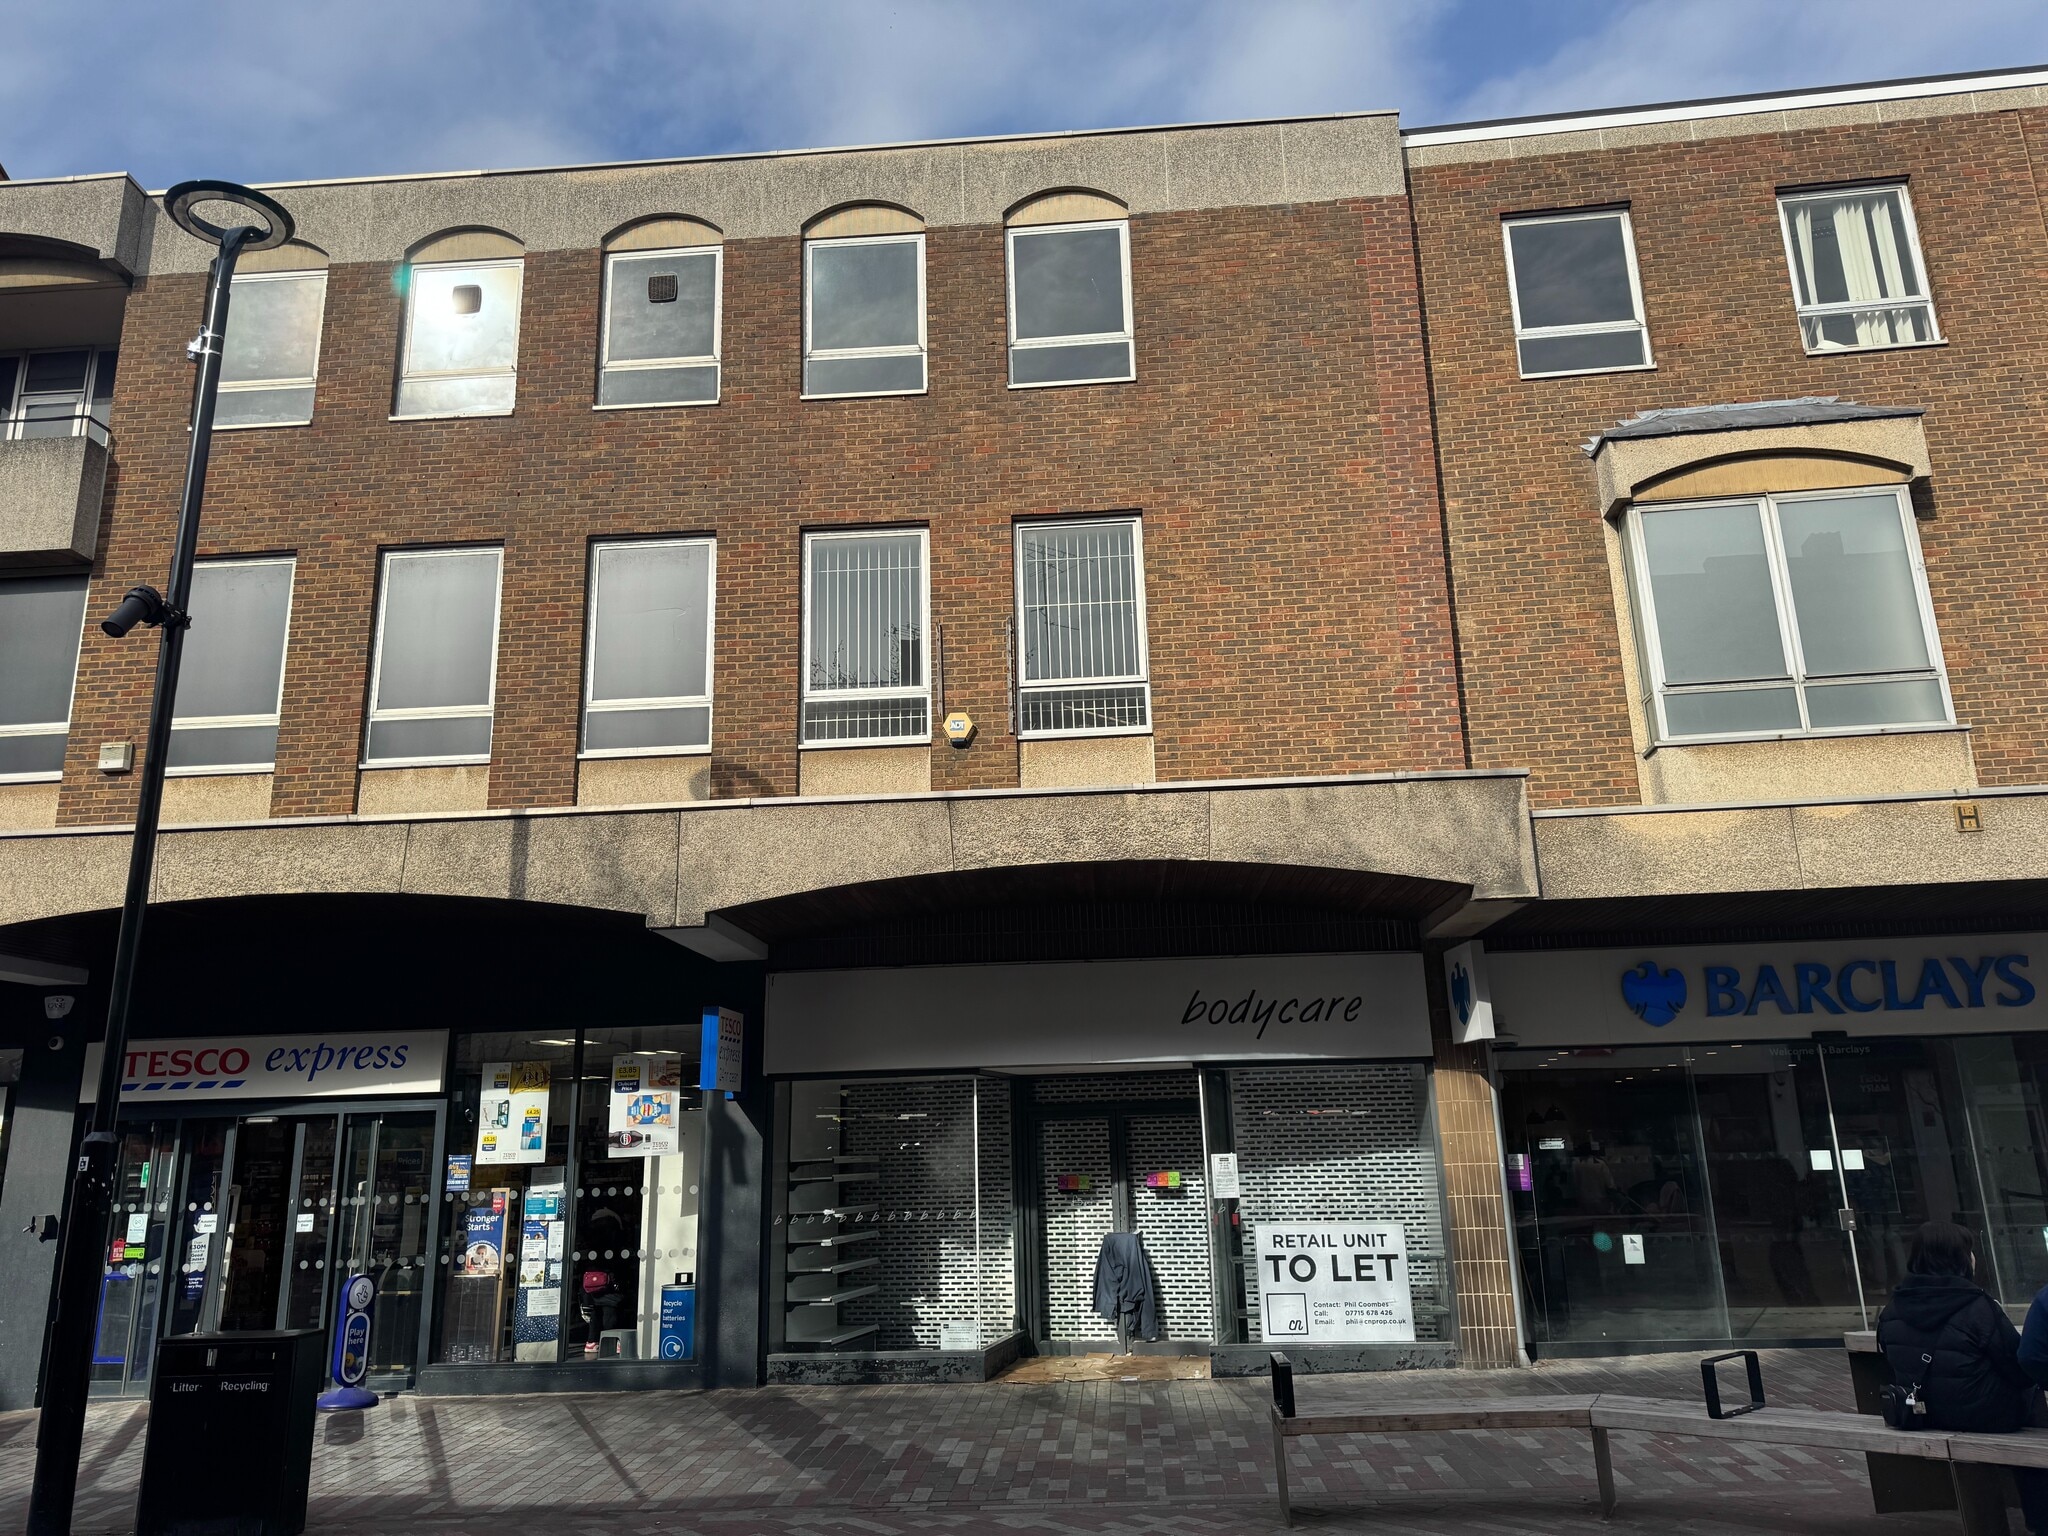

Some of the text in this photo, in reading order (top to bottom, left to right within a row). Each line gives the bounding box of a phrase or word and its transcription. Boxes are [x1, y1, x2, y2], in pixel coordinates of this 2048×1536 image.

[950, 721, 964, 730] ADT
[1704, 954, 2036, 1017] BARCLAYS
[1181, 989, 1362, 1040] bodycare
[720, 1016, 741, 1036] TESCO
[1769, 1048, 1815, 1056] Welcome
[1829, 1044, 1871, 1056] Barclays
[126, 1042, 409, 1082] TESCO express
[618, 1066, 637, 1074] £3.85
[465, 1214, 500, 1224] Stronger
[466, 1223, 490, 1231] Starts
[1272, 1234, 1387, 1248] RETAIL UNIT
[1265, 1254, 1398, 1282] TO LET
[663, 1300, 682, 1308] Recycle
[1289, 1319, 1304, 1330] cn
[349, 1328, 364, 1337] Play
[348, 1336, 364, 1344] here
[172, 1380, 268, 1392] Litter Recycling
